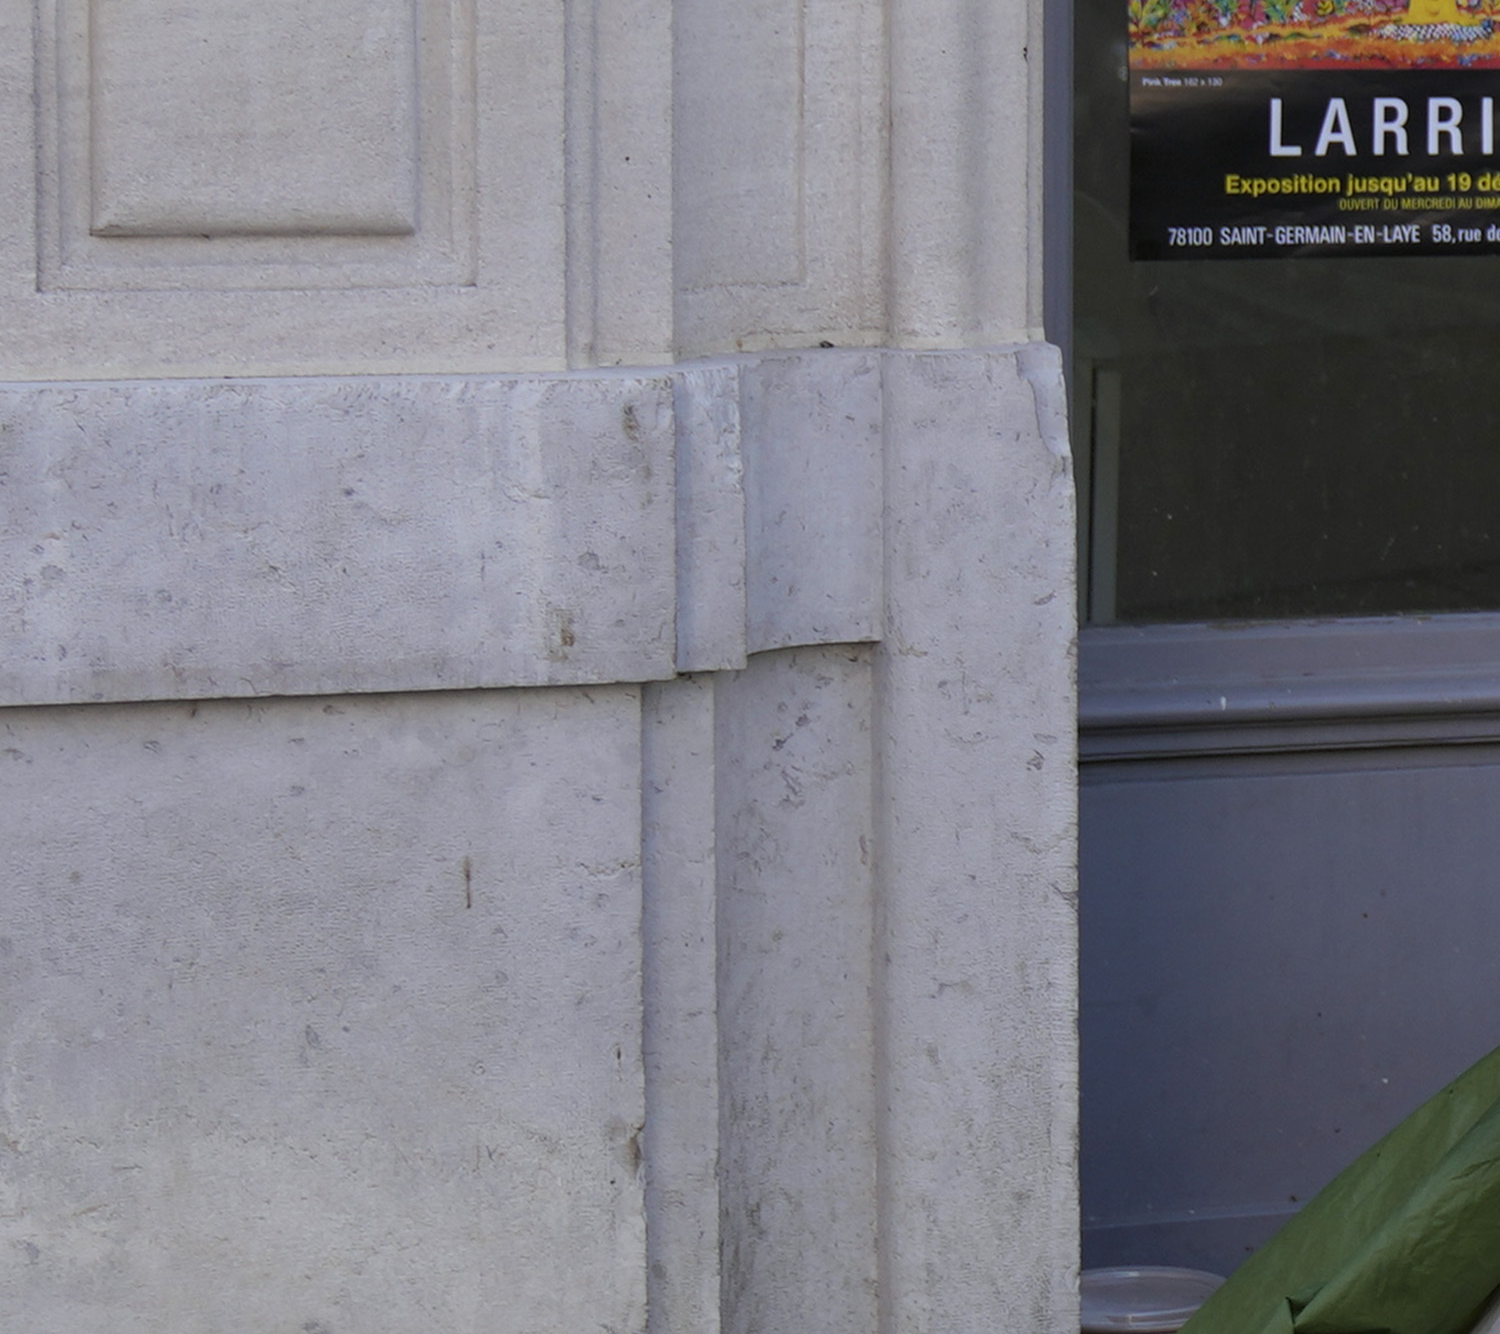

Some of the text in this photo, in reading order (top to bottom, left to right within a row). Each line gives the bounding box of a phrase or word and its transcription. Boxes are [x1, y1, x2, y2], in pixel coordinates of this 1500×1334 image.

[1225, 174, 1341, 198] Exposition
[1346, 172, 1439, 196] jusqu'au
[1447, 173, 1472, 192] 19
[1339, 197, 1379, 211] OUVERT
[1383, 197, 1398, 210] DU
[1400, 197, 1455, 210] MERCREDI
[1457, 197, 1472, 209] AU
[1168, 226, 1213, 246] 78100
[1220, 224, 1421, 245] SAINT-GERMAIN-EN-LAYE
